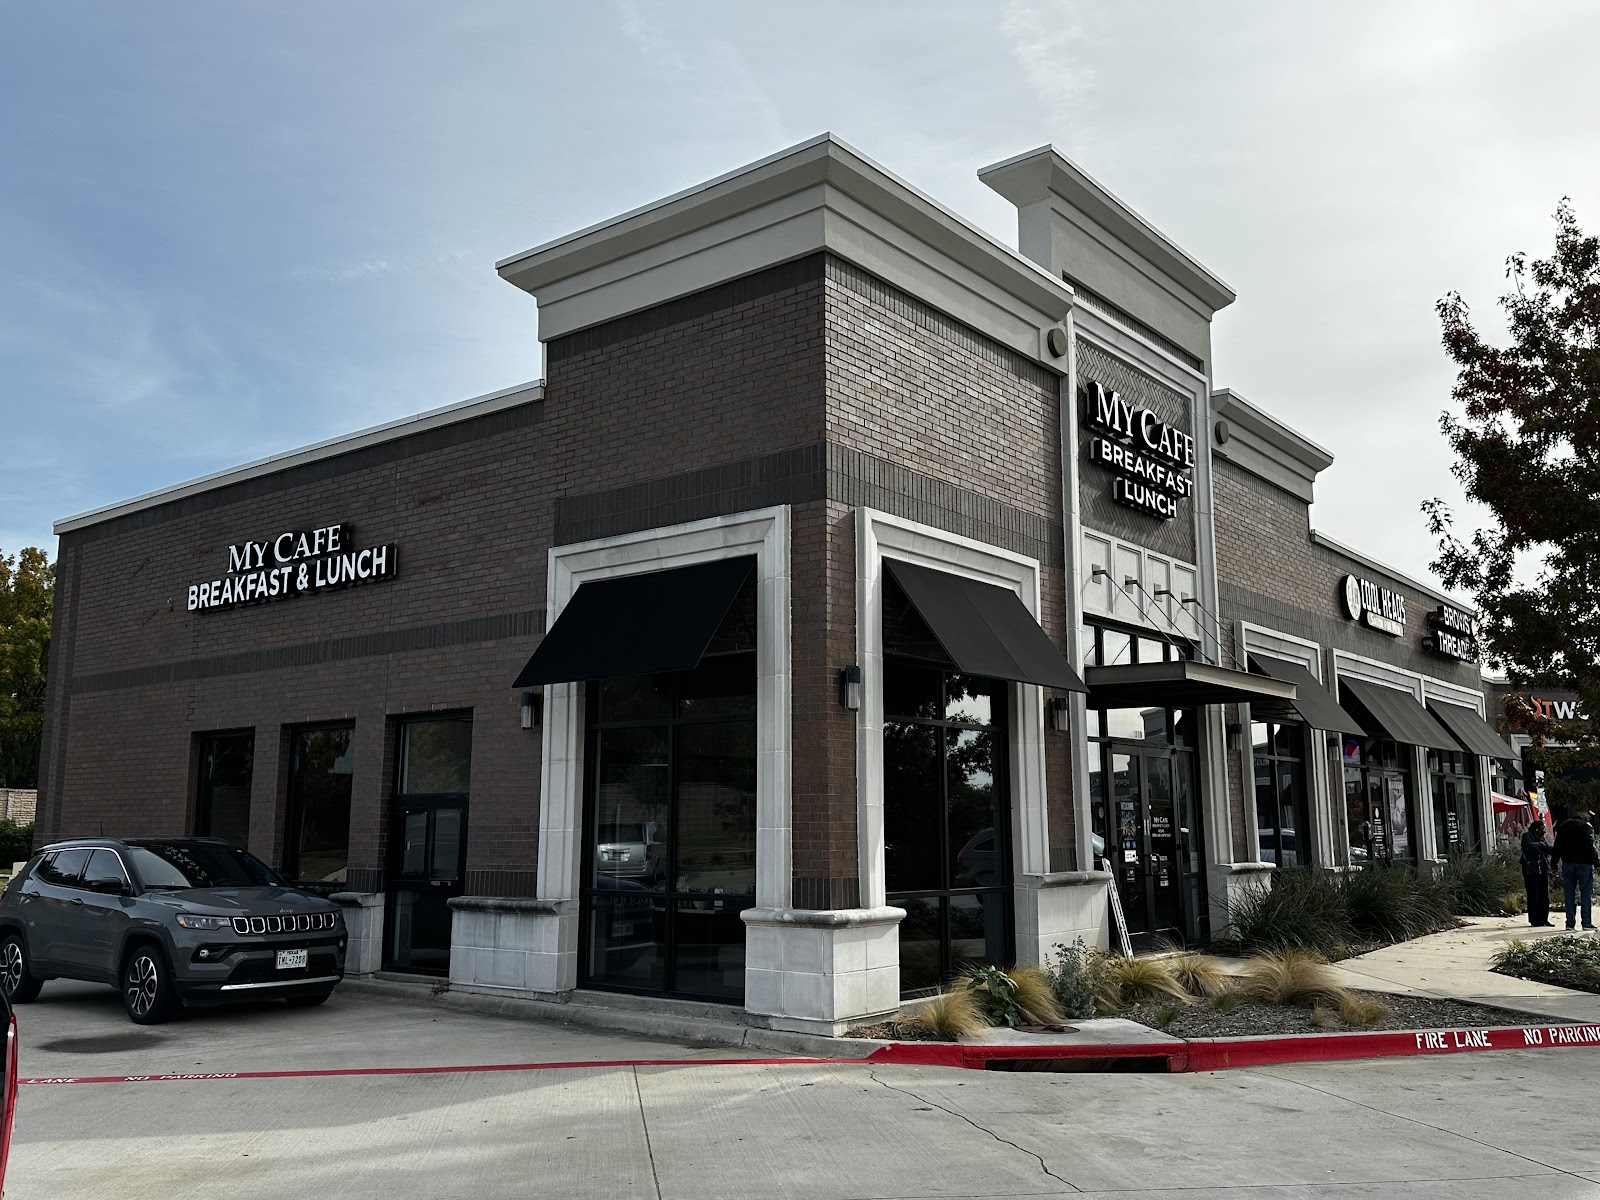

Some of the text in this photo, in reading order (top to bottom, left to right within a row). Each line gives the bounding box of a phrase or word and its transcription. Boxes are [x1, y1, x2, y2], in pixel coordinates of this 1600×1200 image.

[1094, 381, 1195, 468] MY CAFE
[1101, 439, 1193, 497] BREAKFAST
[1124, 479, 1177, 518] LUNCH
[226, 524, 341, 573] MY CAFE
[187, 545, 387, 611] BREAKFAST & LUNCH
[1361, 578, 1381, 615] COOL
[1381, 587, 1407, 625] HEADS
[1443, 605, 1471, 635] BROWS
[1415, 1031, 1449, 1049] FIRE
[1454, 1030, 1492, 1048] LANE
[1523, 1028, 1543, 1045] NO
